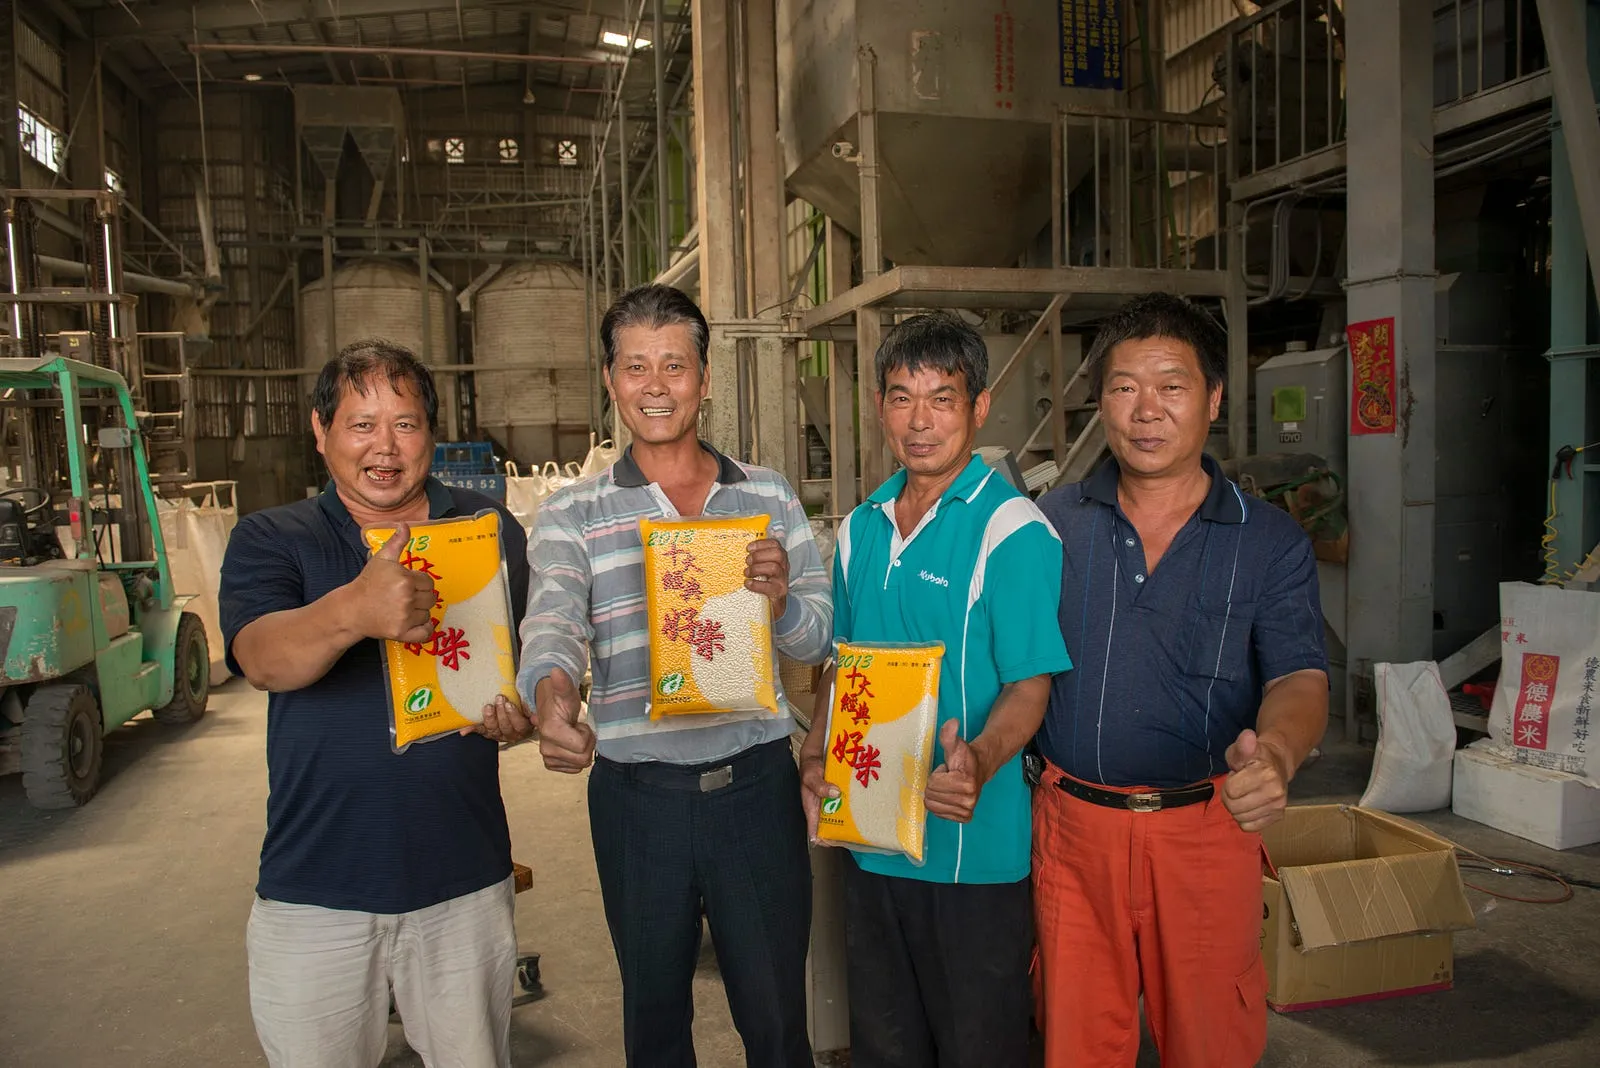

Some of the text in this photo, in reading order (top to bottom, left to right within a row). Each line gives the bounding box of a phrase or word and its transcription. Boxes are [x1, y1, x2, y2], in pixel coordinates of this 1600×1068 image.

[1355, 332, 1375, 379] 大吉
[1280, 433, 1300, 442] TOYO
[648, 530, 695, 546] 2013
[662, 543, 704, 573] 十大
[662, 569, 704, 602] 經典
[917, 569, 949, 588] Kubota
[662, 607, 726, 661] 好米
[837, 654, 874, 669] 2013
[845, 666, 875, 698] 十大
[840, 692, 871, 725] 經典
[1517, 681, 1549, 746] 德農米
[832, 729, 882, 788] 好米
